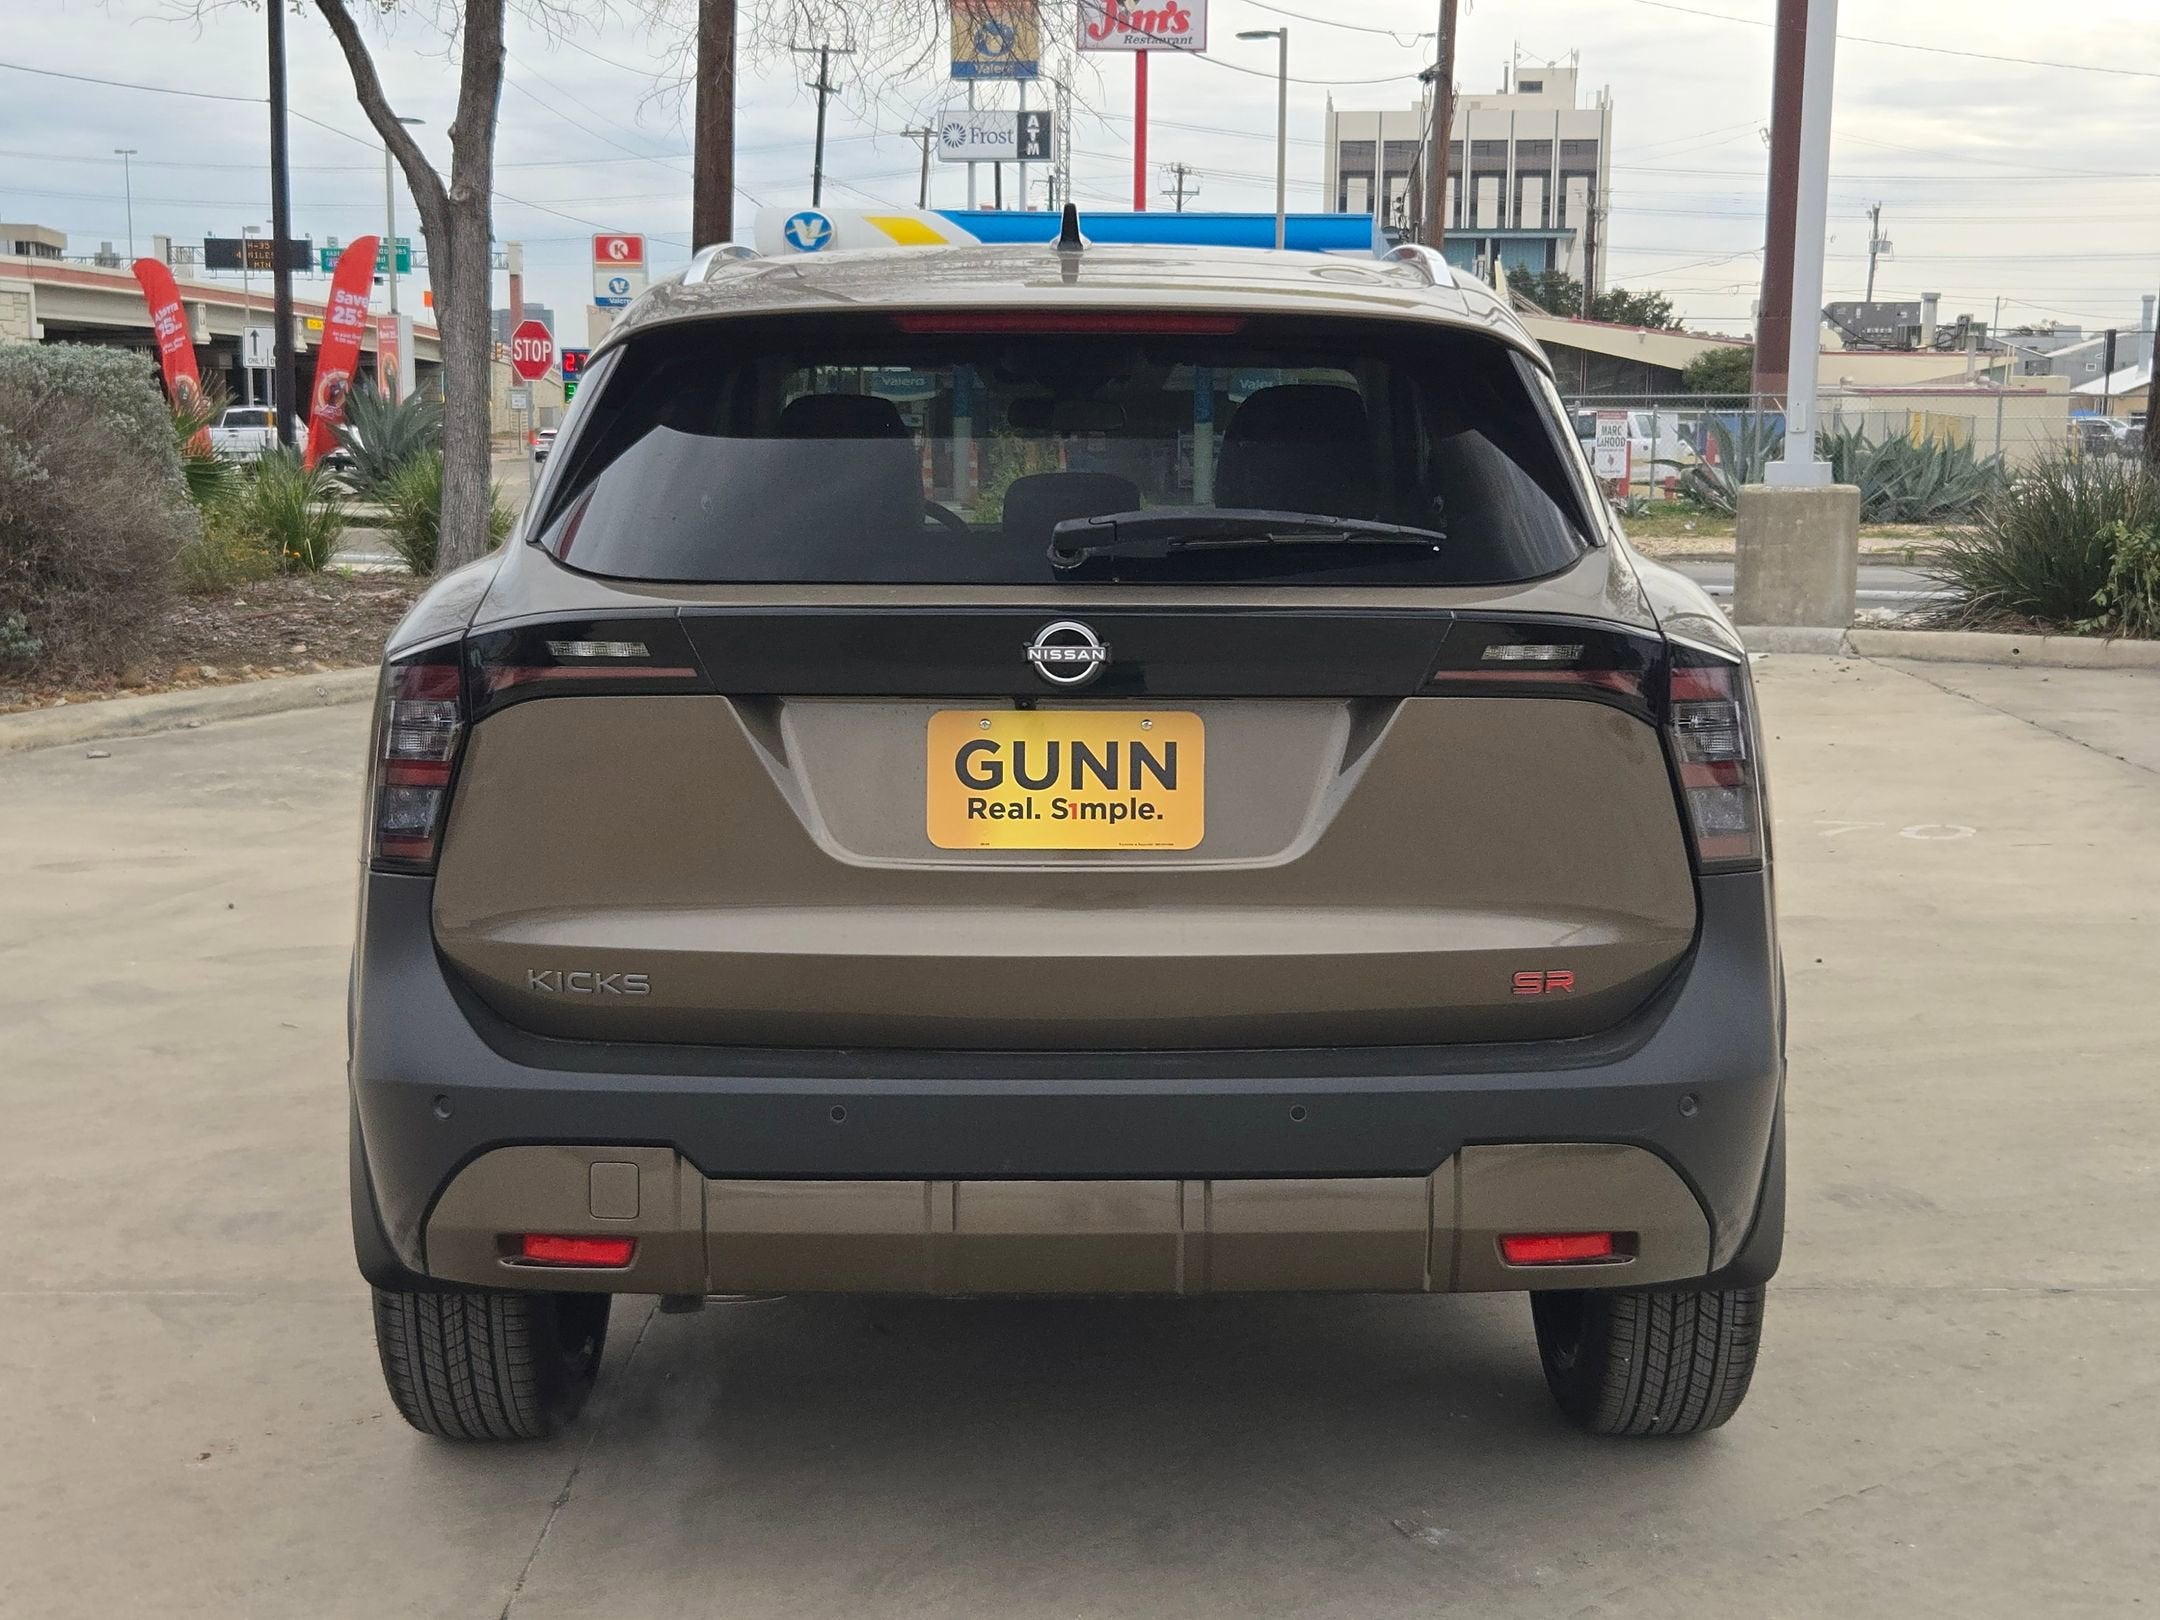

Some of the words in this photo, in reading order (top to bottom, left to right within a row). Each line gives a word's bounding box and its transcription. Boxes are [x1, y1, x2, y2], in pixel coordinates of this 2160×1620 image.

[1087, 0, 1192, 42] Jim's
[1123, 34, 1193, 45] Restaurant
[969, 126, 1015, 144] Frost
[1026, 114, 1041, 156] ATM
[335, 290, 369, 308] Save
[513, 339, 552, 362] STOP
[881, 377, 926, 387] Valero
[1601, 425, 1623, 436] MARC
[1028, 649, 1106, 661] NISSAN
[954, 739, 1178, 791] GUNN
[967, 797, 1041, 820] Real.
[527, 969, 653, 996] KICKS
[1511, 969, 1576, 996] SR
